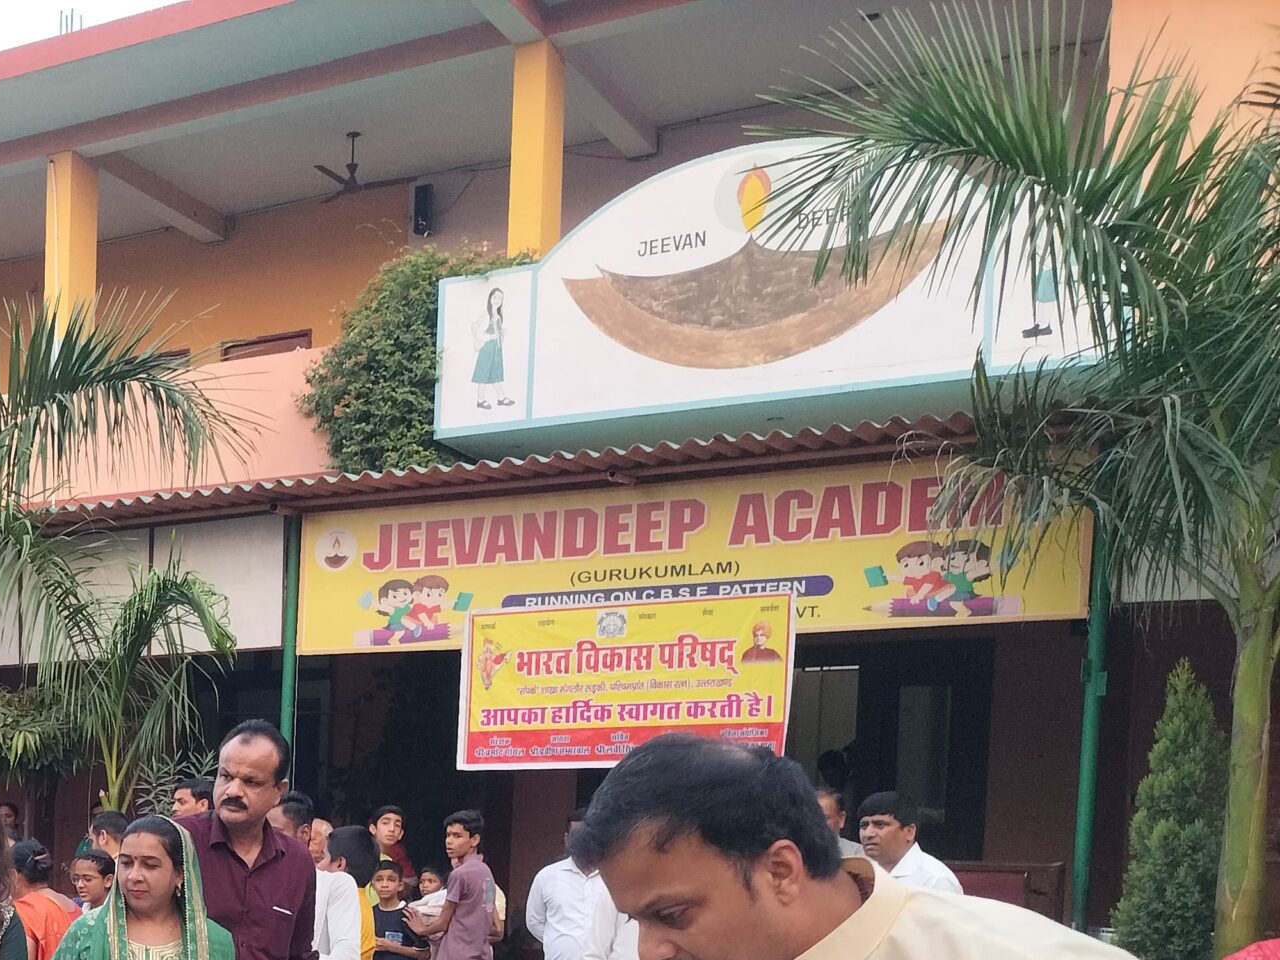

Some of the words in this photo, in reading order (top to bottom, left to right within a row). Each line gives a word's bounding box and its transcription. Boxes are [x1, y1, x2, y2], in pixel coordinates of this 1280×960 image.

[638, 230, 707, 257] JEEVAN
[363, 499, 706, 571] JEEVANDEEP
[728, 470, 1032, 546] ACADEM
[570, 561, 740, 587] (GURUKUMLAM)
[526, 592, 605, 607] RUNNING
[610, 591, 637, 602] ON
[719, 580, 806, 596] PATTERN
[795, 606, 821, 618] VT.
[516, 649, 573, 676] भारत
[576, 640, 655, 674] विकास
[658, 634, 740, 675] परिषद्
[480, 706, 548, 727] आपका
[551, 699, 613, 724] हार्दिक
[617, 702, 682, 722] स्वागत
[686, 694, 744, 719] करती
